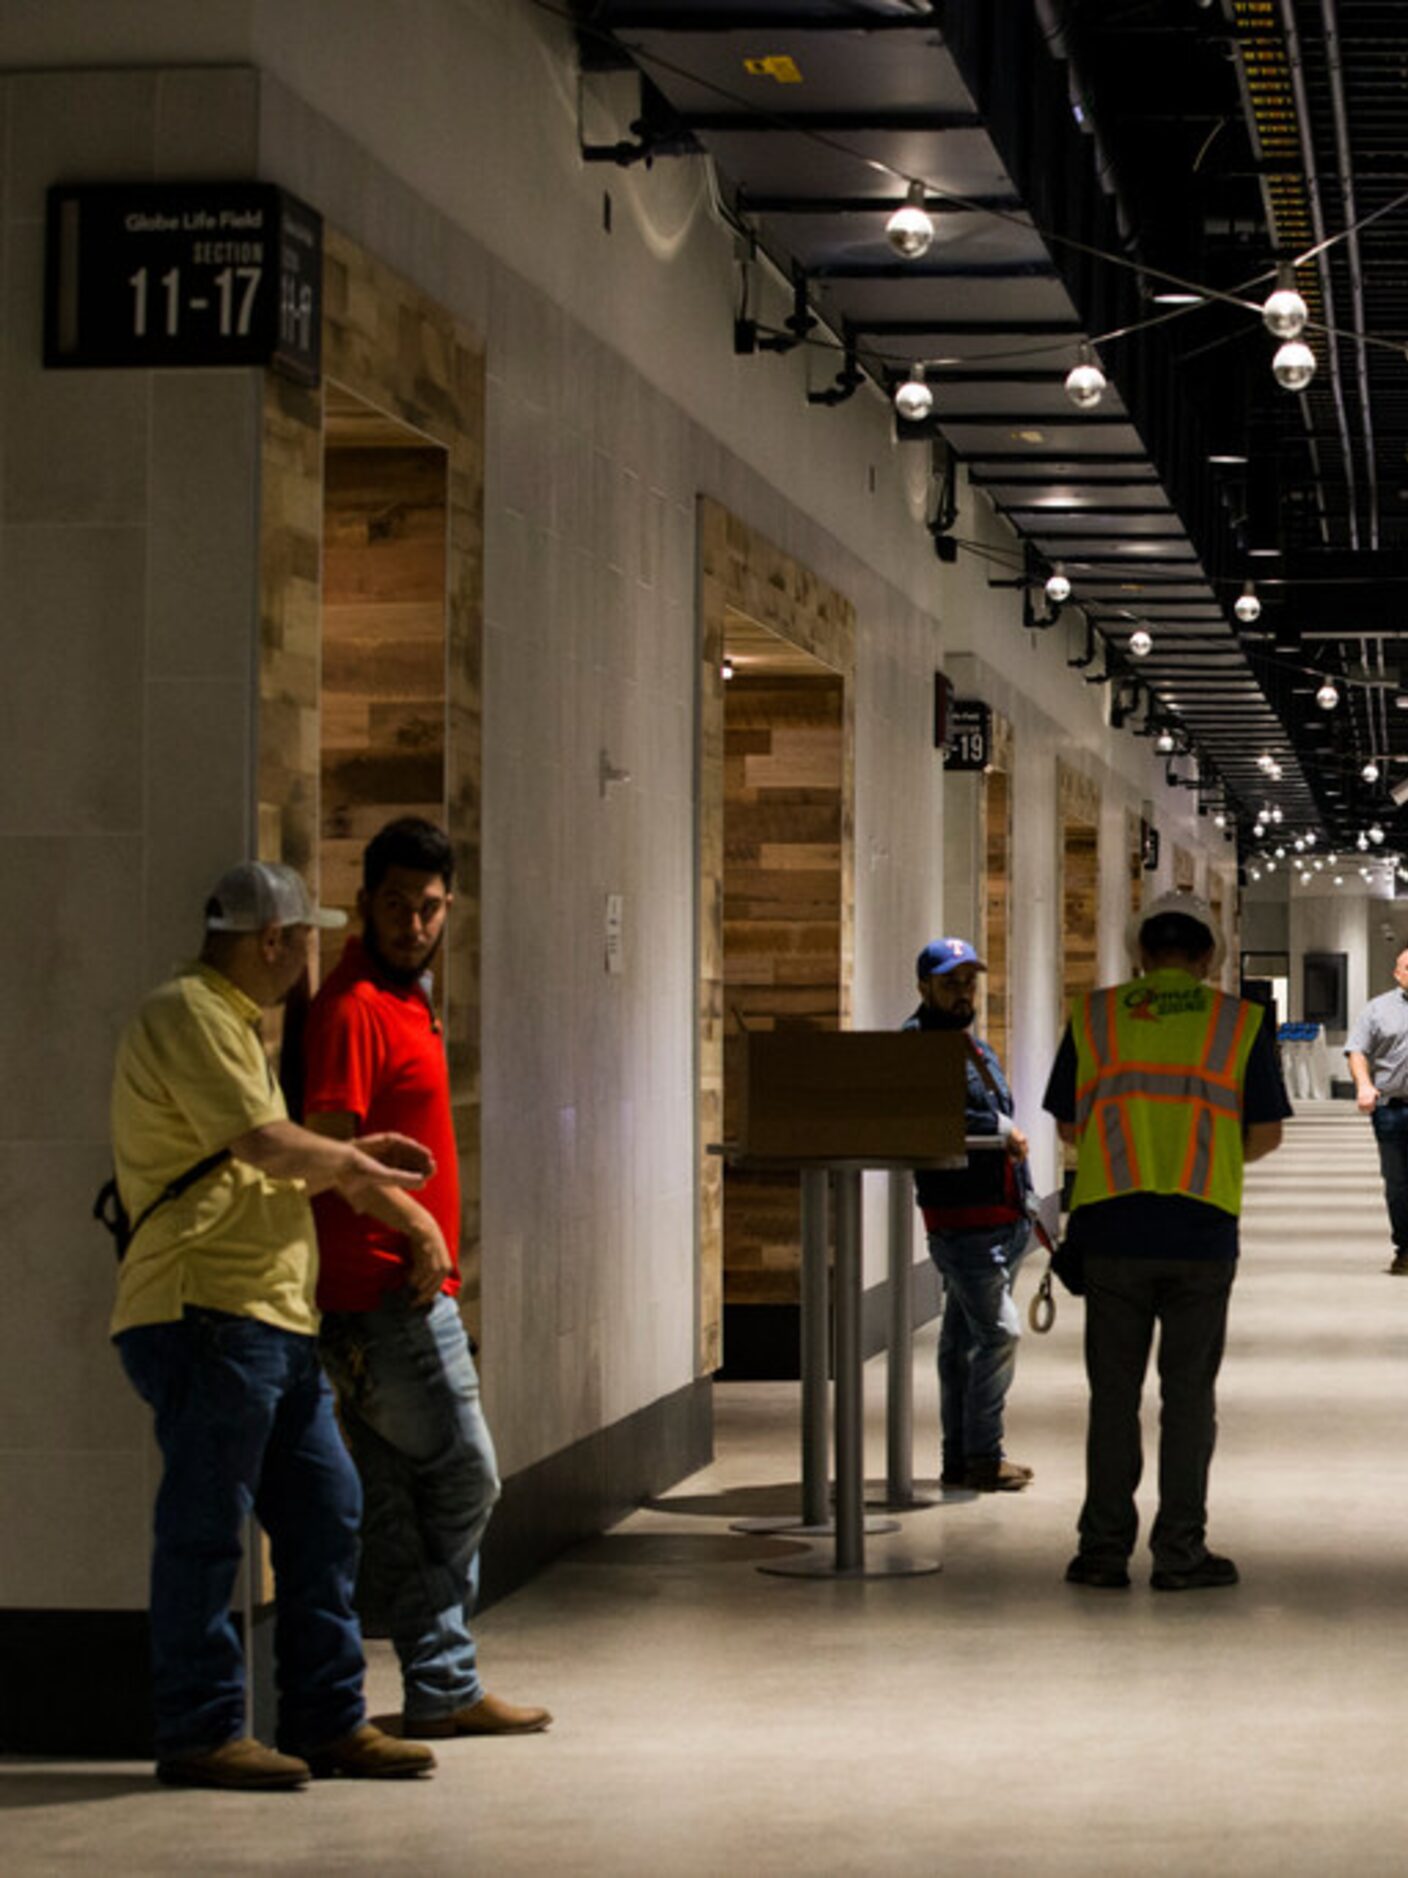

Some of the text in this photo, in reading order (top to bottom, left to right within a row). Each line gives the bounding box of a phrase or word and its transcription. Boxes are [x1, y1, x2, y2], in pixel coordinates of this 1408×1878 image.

[124, 212, 179, 232] Globe
[181, 209, 217, 231] Life
[219, 209, 264, 230] Field
[193, 241, 264, 264] SECTION
[128, 266, 263, 337] 11-17
[944, 735, 983, 763] -19
